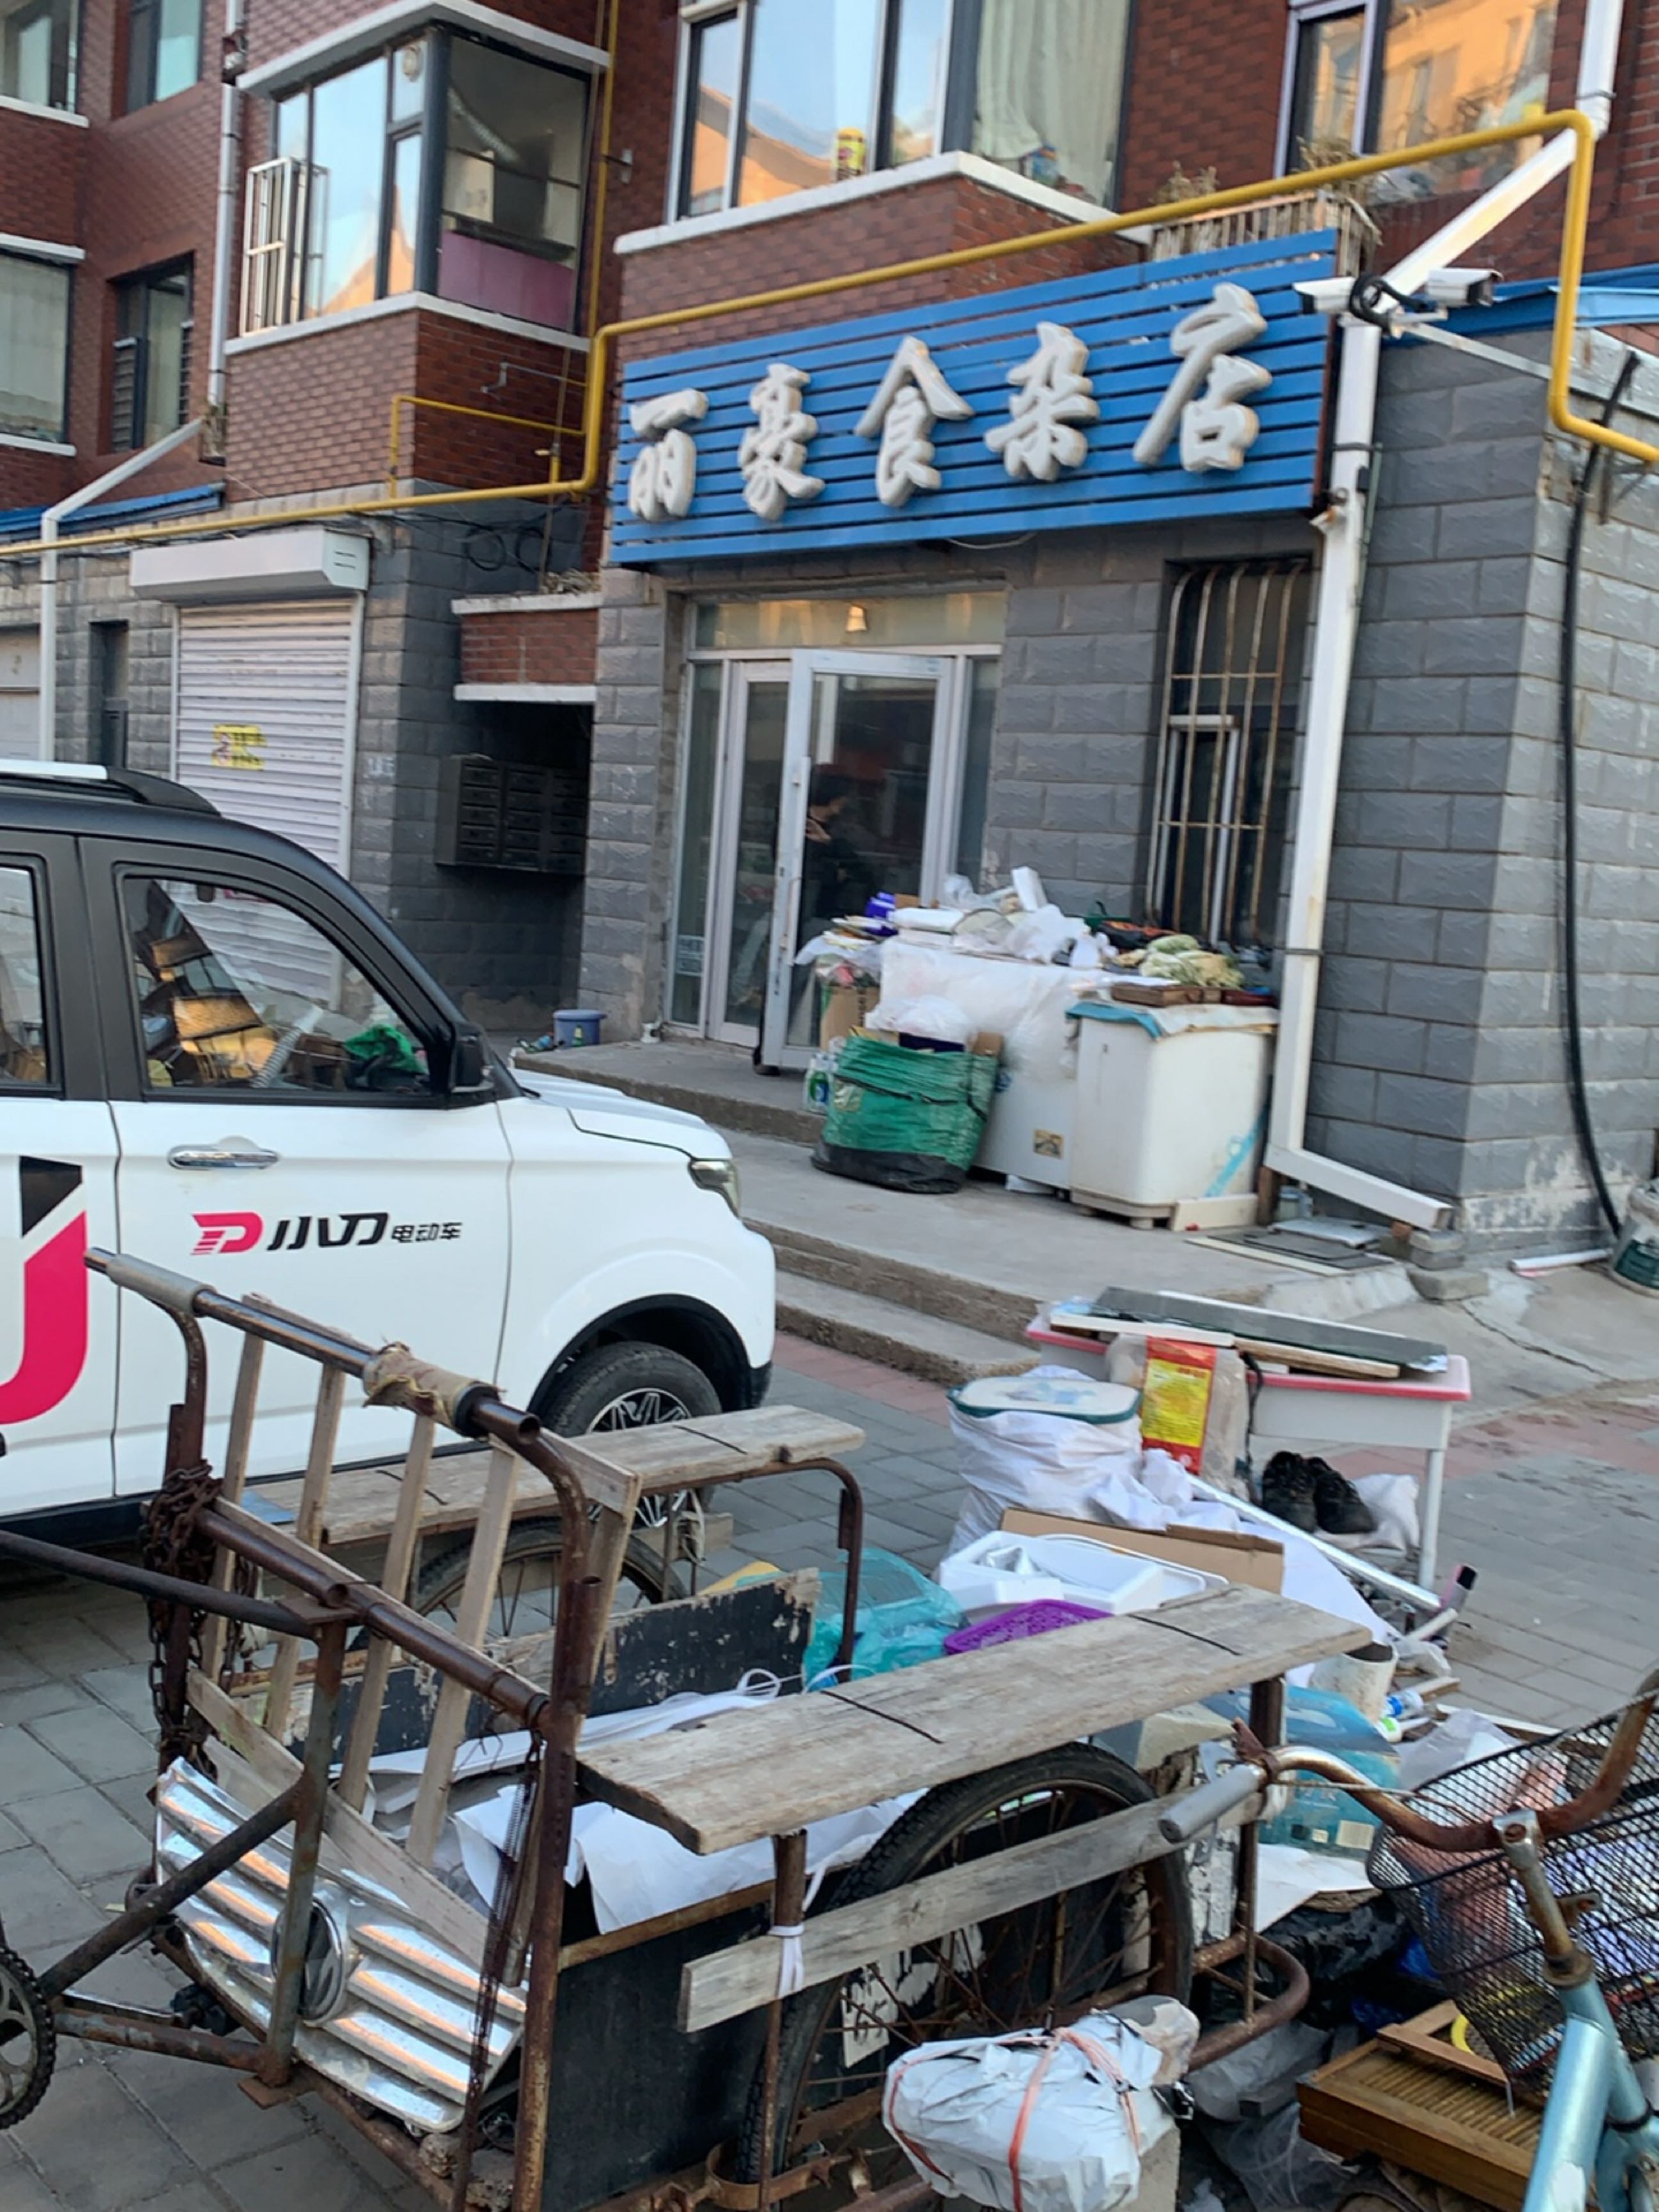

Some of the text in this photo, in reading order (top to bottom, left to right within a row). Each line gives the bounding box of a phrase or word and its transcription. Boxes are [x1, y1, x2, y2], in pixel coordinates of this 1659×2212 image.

[629, 282, 1272, 522] 丽豪食杂店
